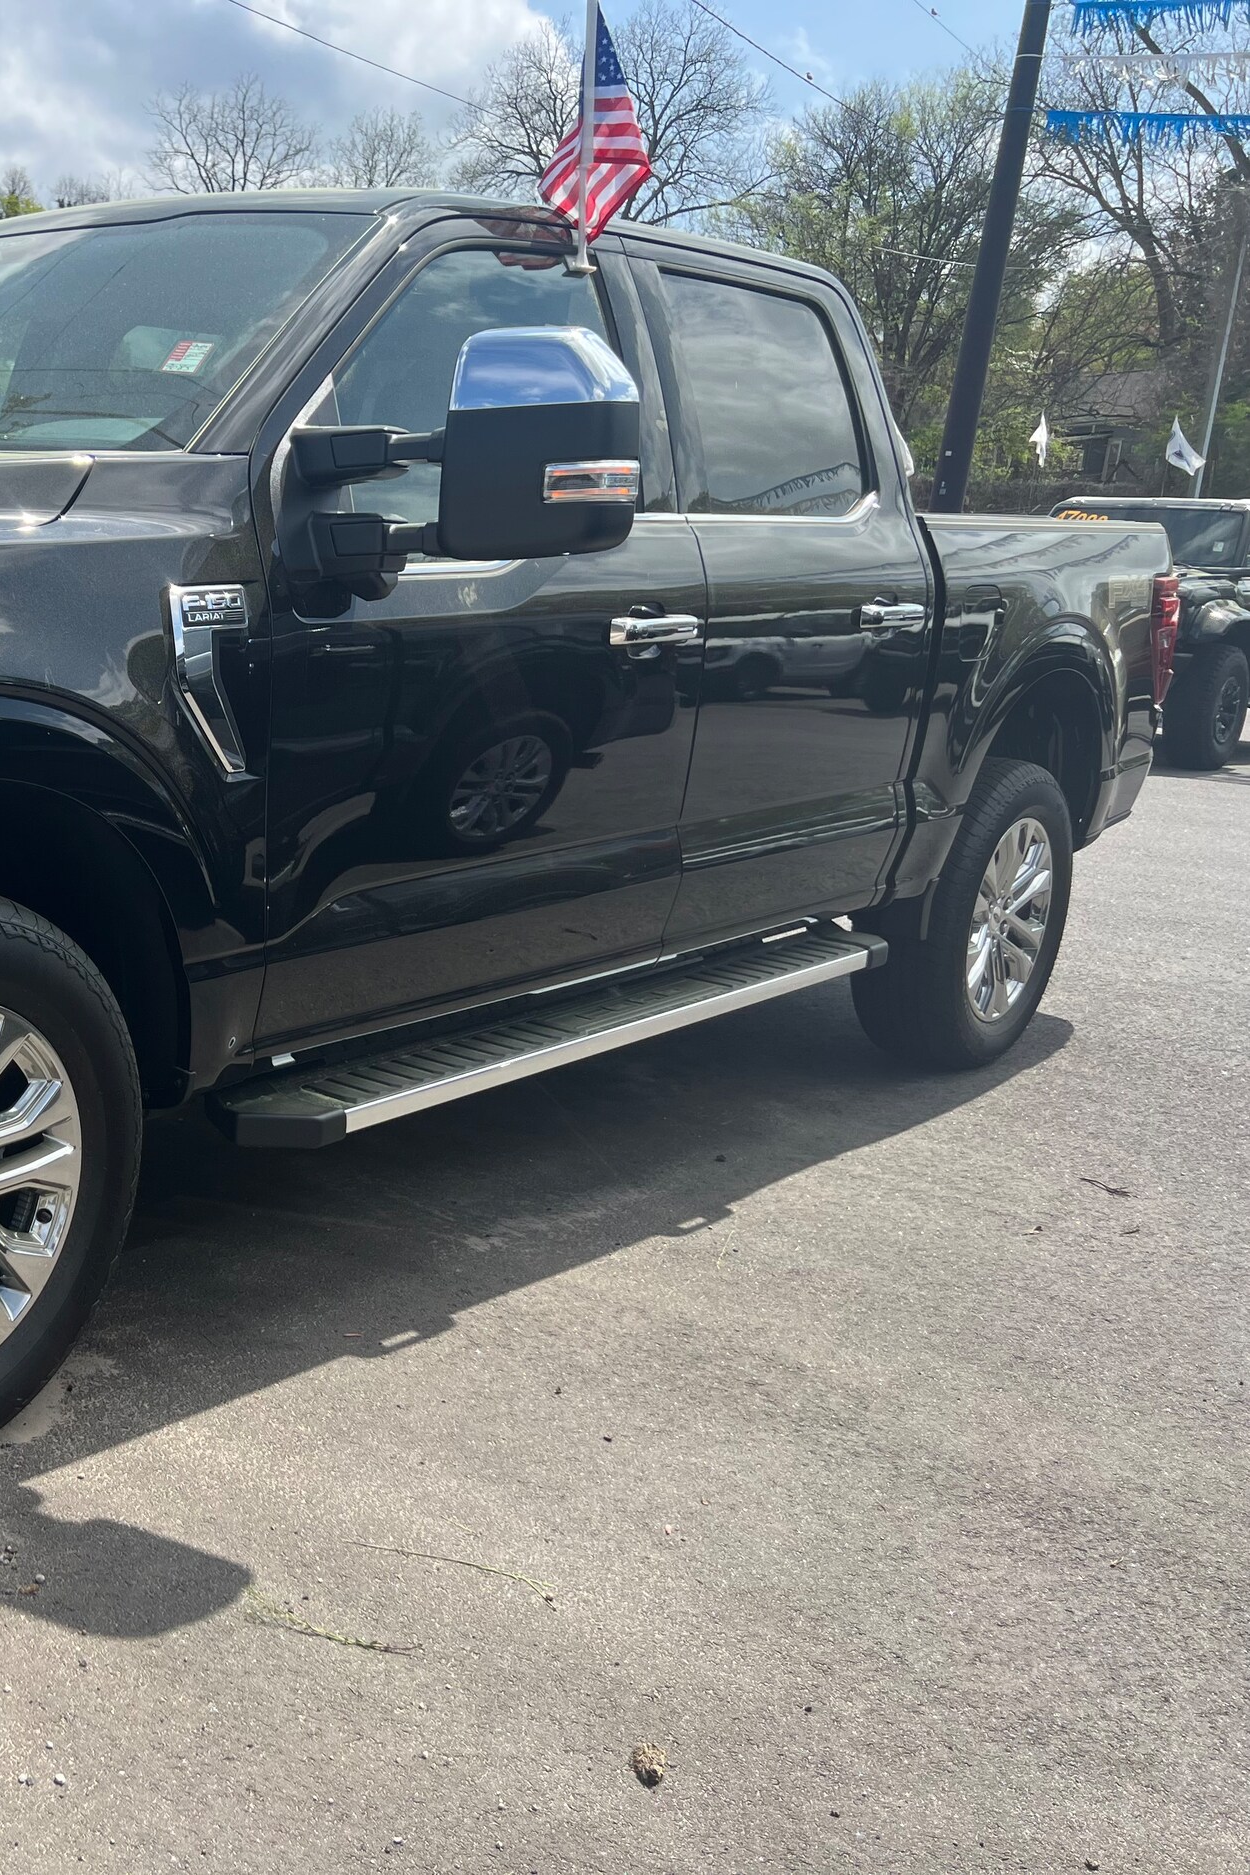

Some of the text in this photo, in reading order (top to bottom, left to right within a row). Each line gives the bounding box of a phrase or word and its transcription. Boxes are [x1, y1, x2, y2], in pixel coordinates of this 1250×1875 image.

[182, 591, 241, 611] F-150
[1108, 574, 1150, 609] FX4
[187, 612, 224, 622] LARIAT
